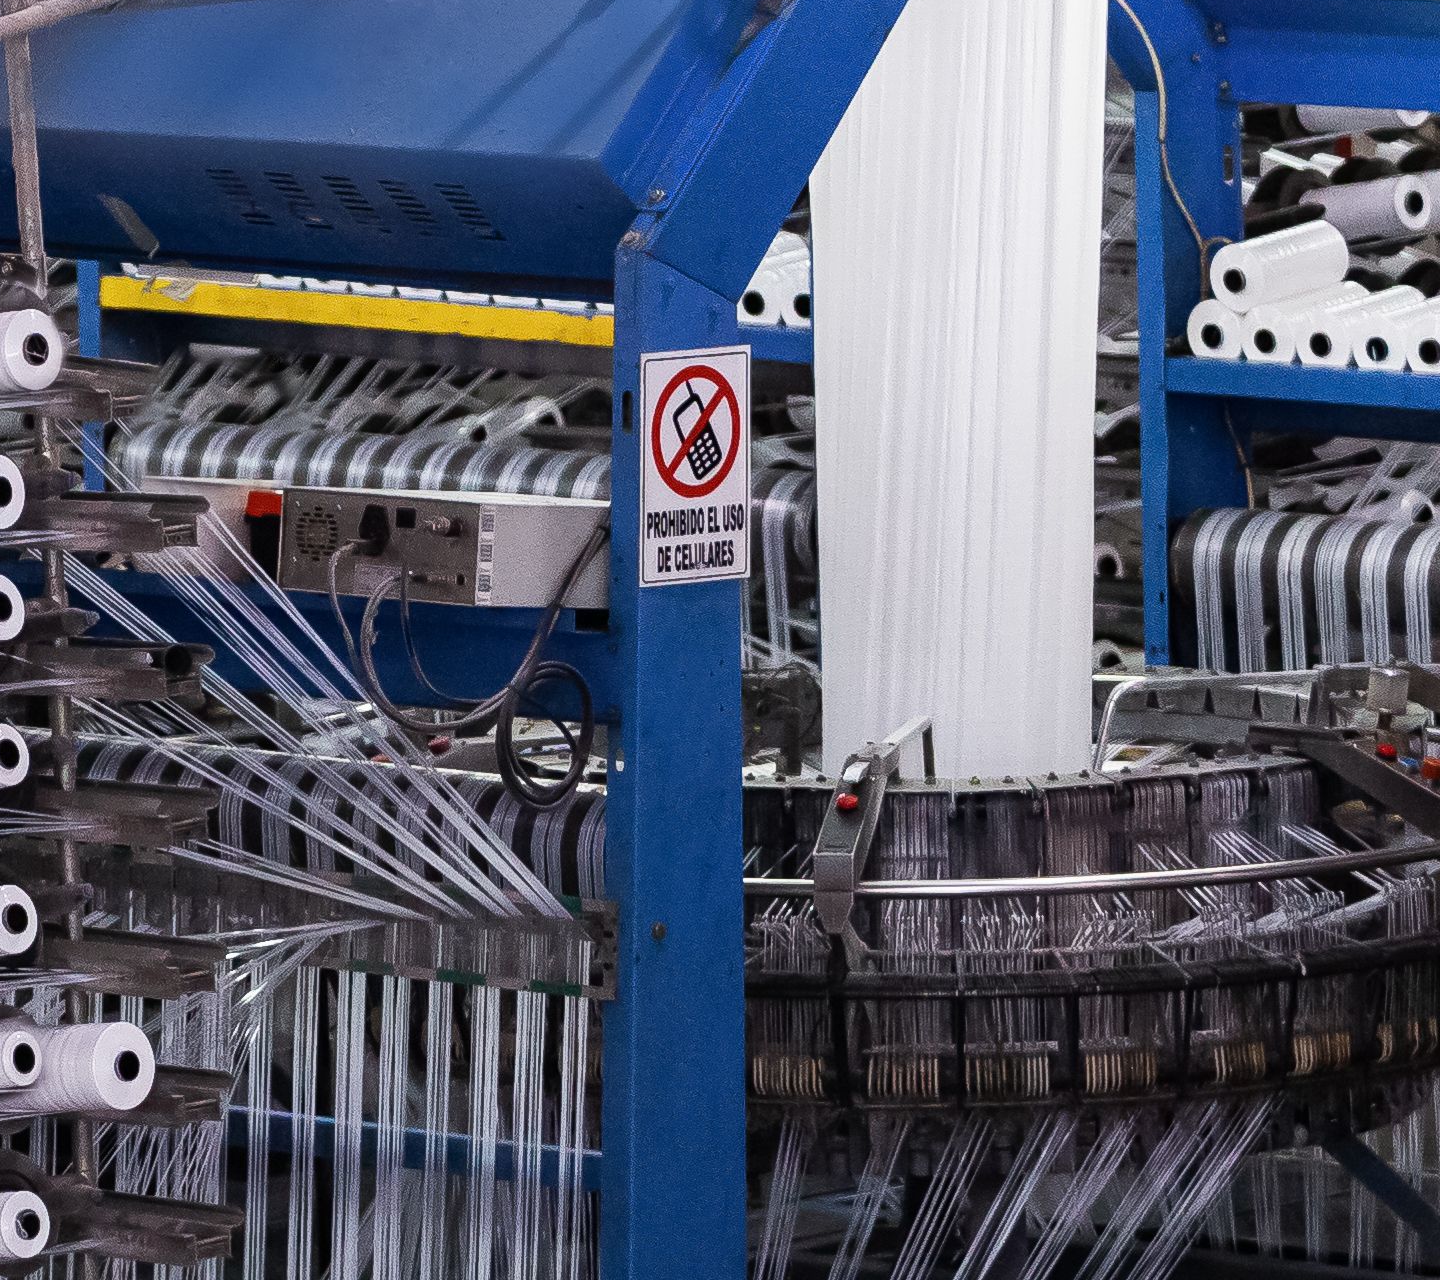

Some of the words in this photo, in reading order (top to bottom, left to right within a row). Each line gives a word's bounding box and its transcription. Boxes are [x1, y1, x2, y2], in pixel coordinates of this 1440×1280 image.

[646, 507, 705, 539] PROHIBIDO
[708, 506, 720, 533] EL
[722, 503, 744, 532] USO
[657, 545, 671, 573] DE
[674, 539, 734, 571] CELULARES
